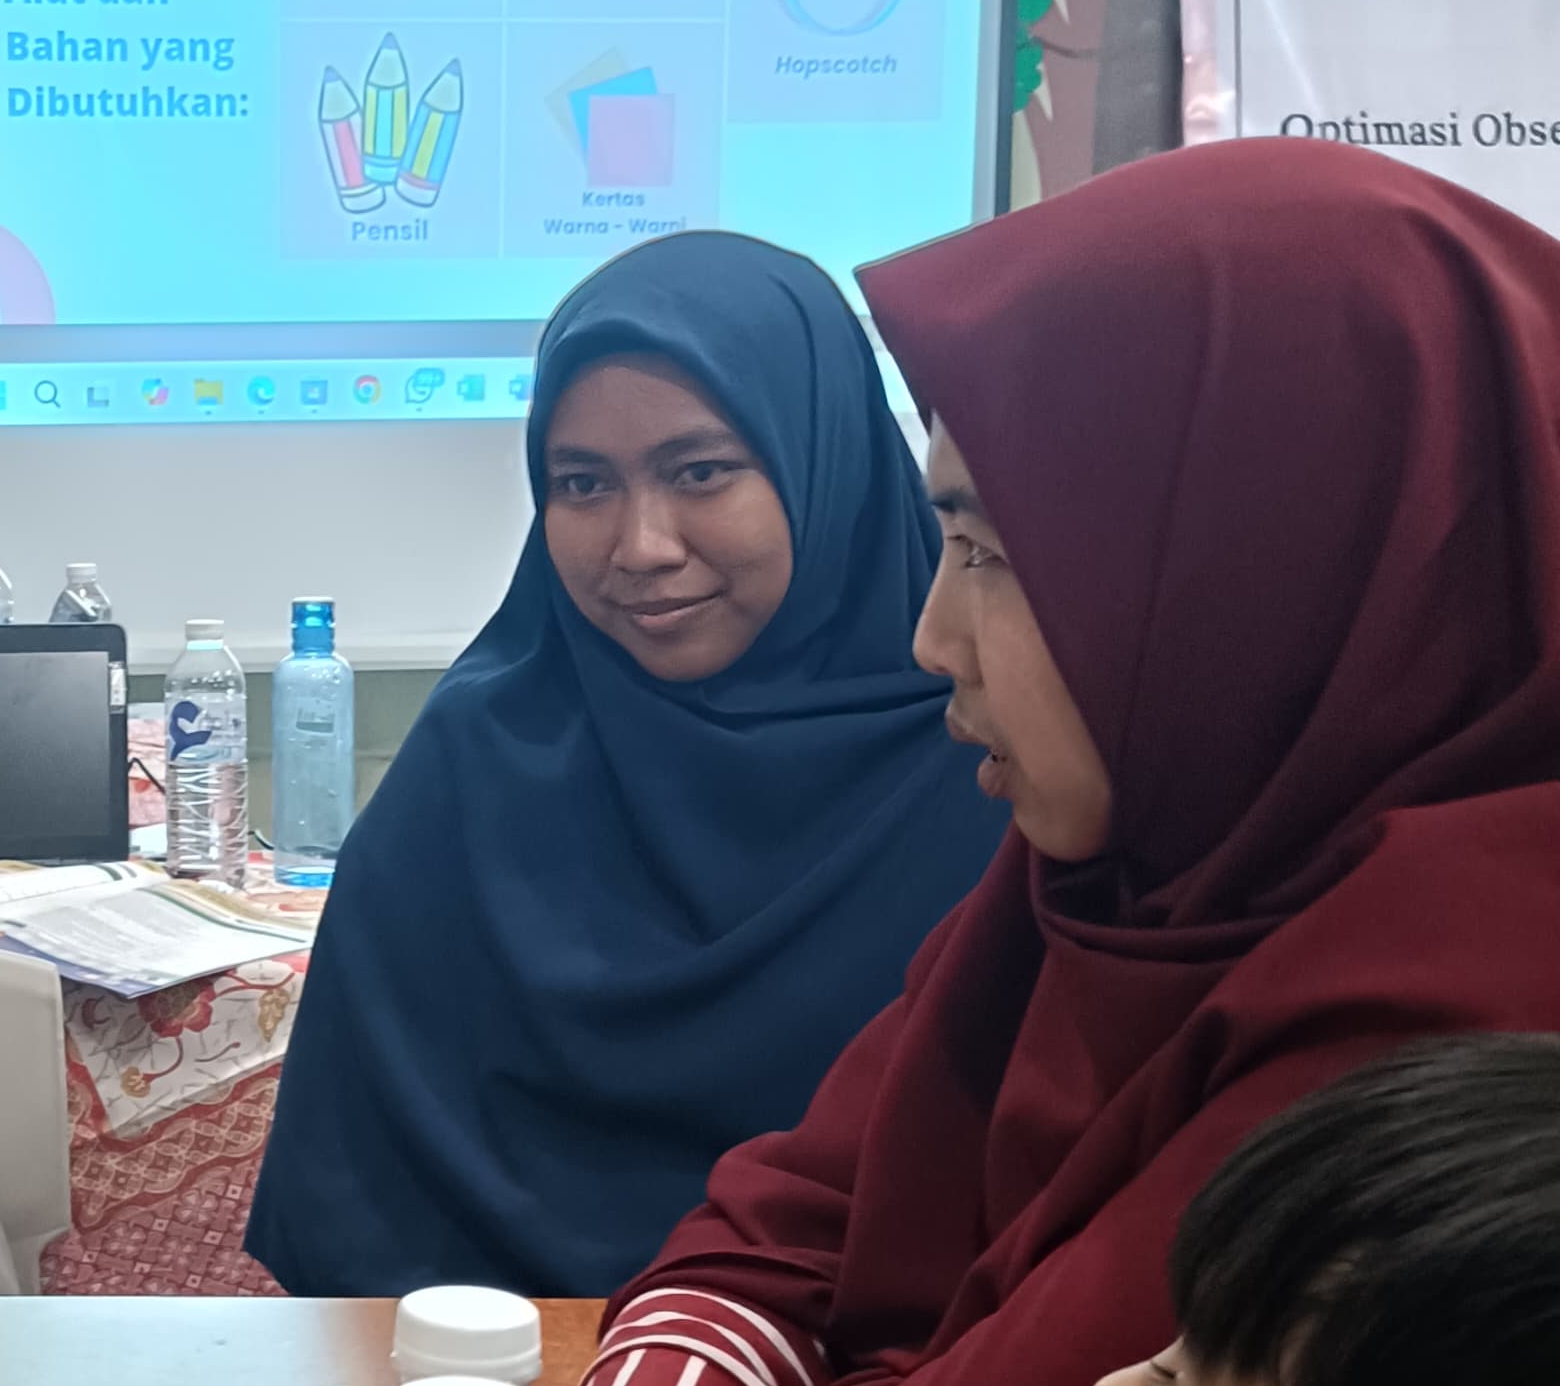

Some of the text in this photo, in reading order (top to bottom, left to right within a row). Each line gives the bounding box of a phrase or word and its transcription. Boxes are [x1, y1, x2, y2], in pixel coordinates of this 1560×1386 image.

[6, 31, 235, 71] Bahan yang
[776, 55, 897, 78] Hopscotch
[7, 87, 250, 118] Dibutuhkan:
[1280, 111, 1462, 146] Optimasi
[582, 191, 646, 207] Kertas
[351, 218, 428, 242] Pensil
[544, 218, 609, 234] Warna
